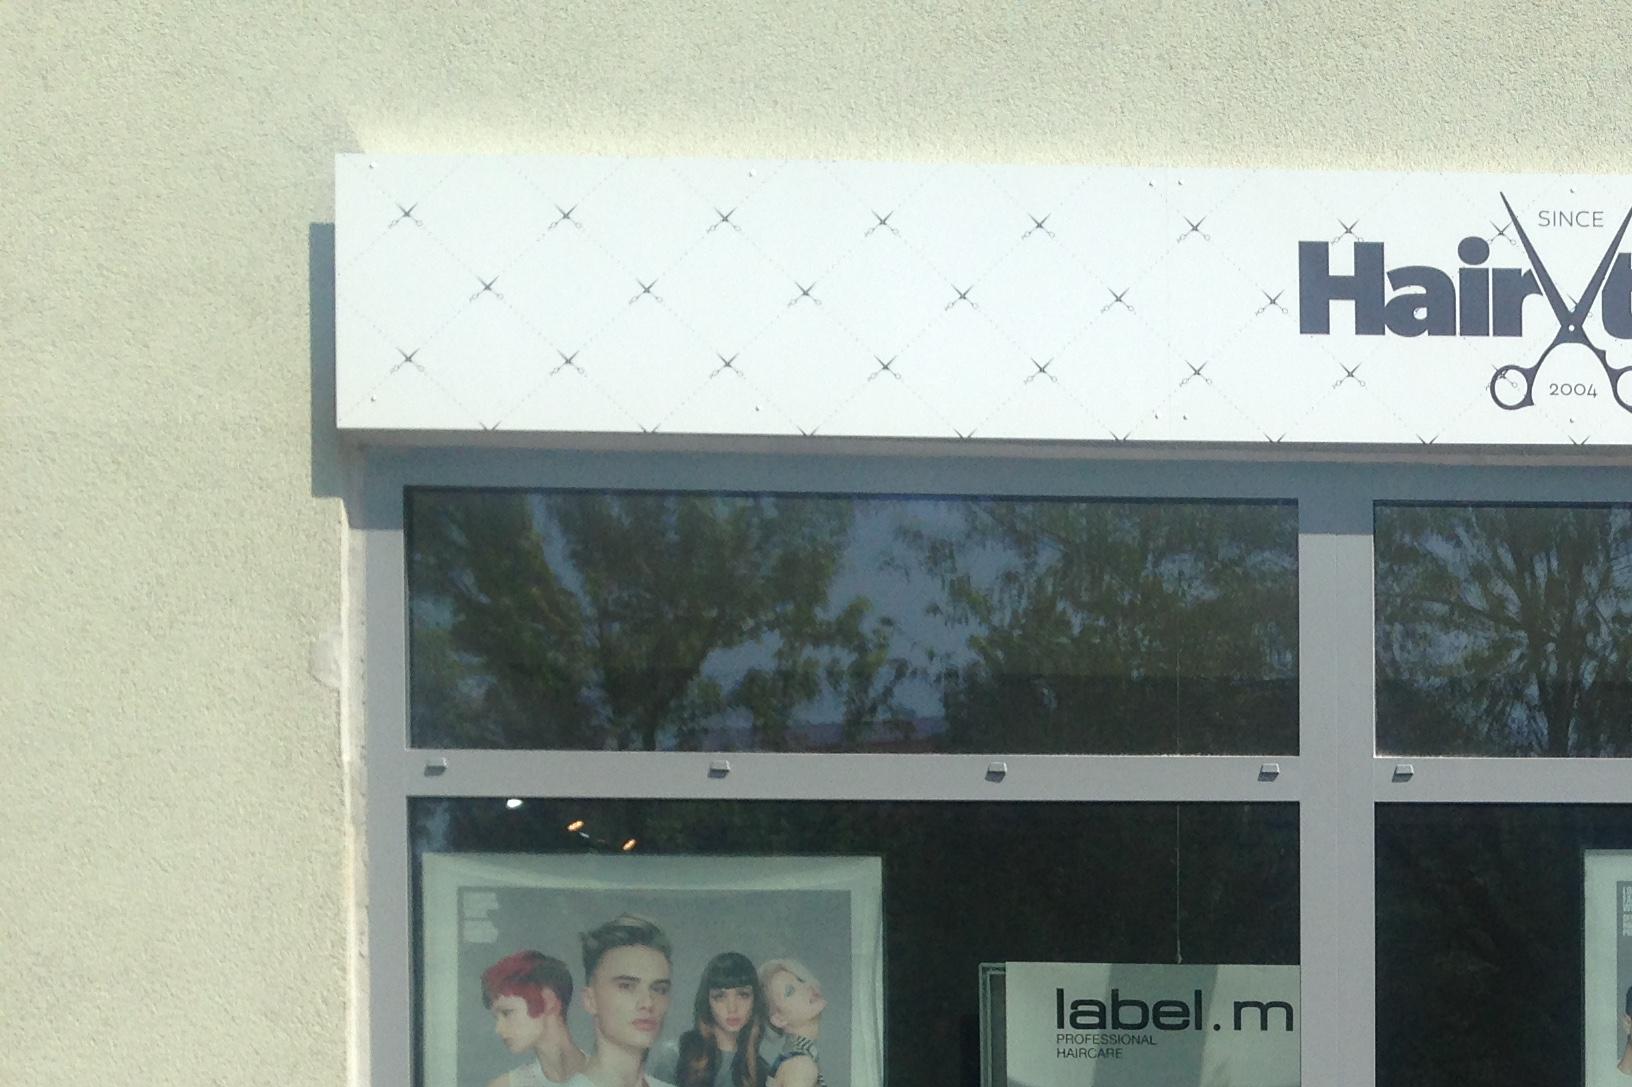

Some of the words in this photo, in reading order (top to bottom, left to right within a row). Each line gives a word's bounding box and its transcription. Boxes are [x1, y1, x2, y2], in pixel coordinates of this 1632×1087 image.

[1538, 211, 1604, 227] SINCE
[1299, 236, 1543, 338] Hair
[1549, 383, 1598, 398] 2004
[1056, 1033, 1157, 1046] PROFESSIONAL
[1056, 1047, 1123, 1059] HAIRCARE
